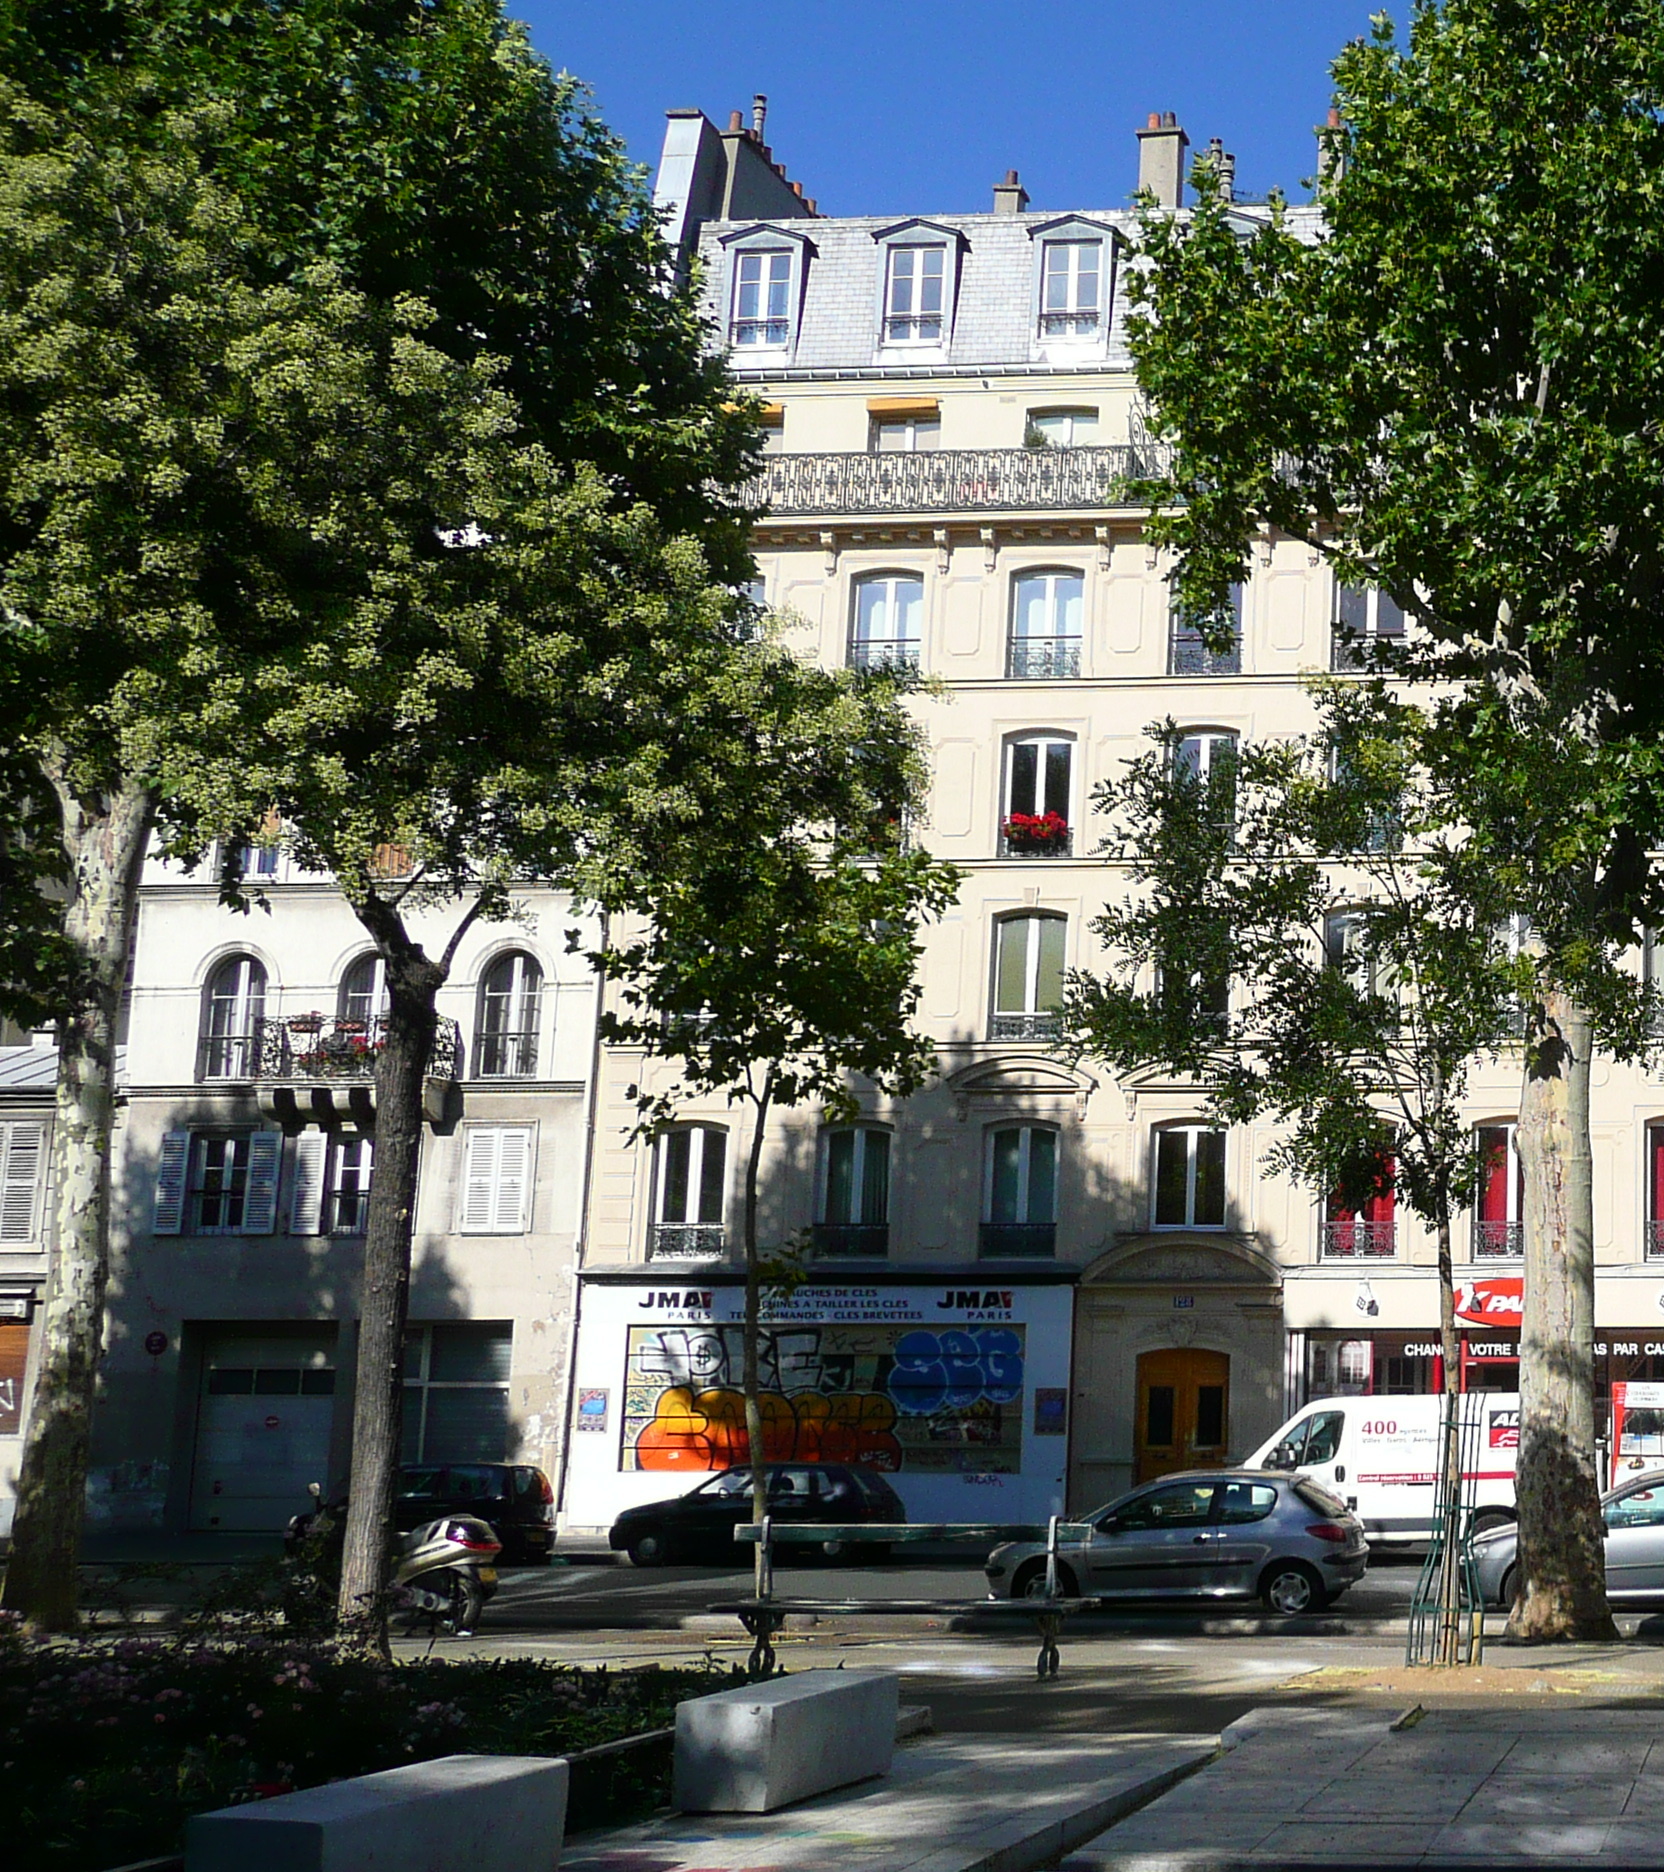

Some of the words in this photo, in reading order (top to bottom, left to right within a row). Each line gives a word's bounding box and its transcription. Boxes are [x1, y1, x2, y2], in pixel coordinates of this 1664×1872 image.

[835, 1288, 848, 1298] DE
[639, 1291, 706, 1309] JMA
[815, 1299, 856, 1309] TAILLER
[861, 1299, 878, 1309] LES
[937, 1291, 1005, 1309] JMA
[668, 1311, 712, 1320] PARIS
[968, 1311, 1012, 1320] PARIS
[1469, 1343, 1512, 1356] VOTRE
[1613, 1343, 1639, 1356] PAR
[1361, 1420, 1397, 1435] 400
